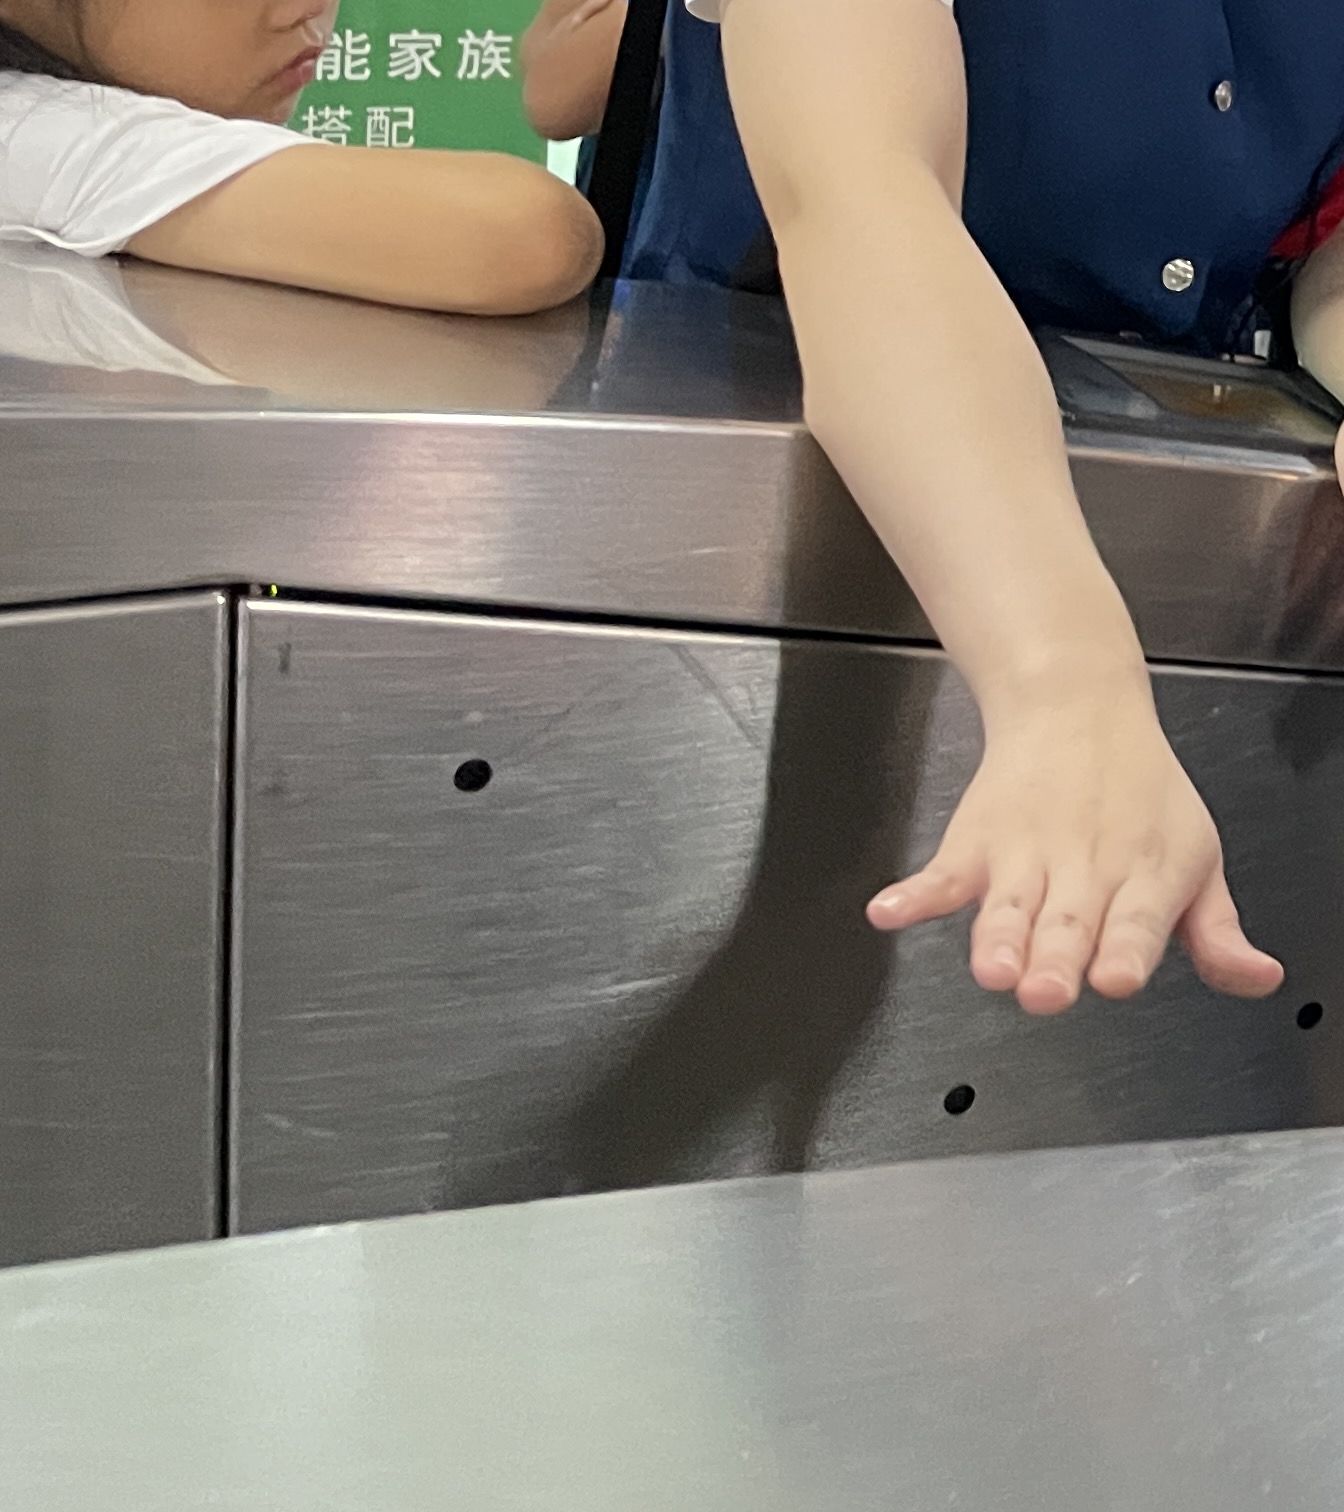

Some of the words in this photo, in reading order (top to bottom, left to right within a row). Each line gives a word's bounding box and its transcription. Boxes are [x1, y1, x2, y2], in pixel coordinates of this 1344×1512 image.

[314, 29, 514, 81] 能家族
[301, 105, 415, 148] 搭配
